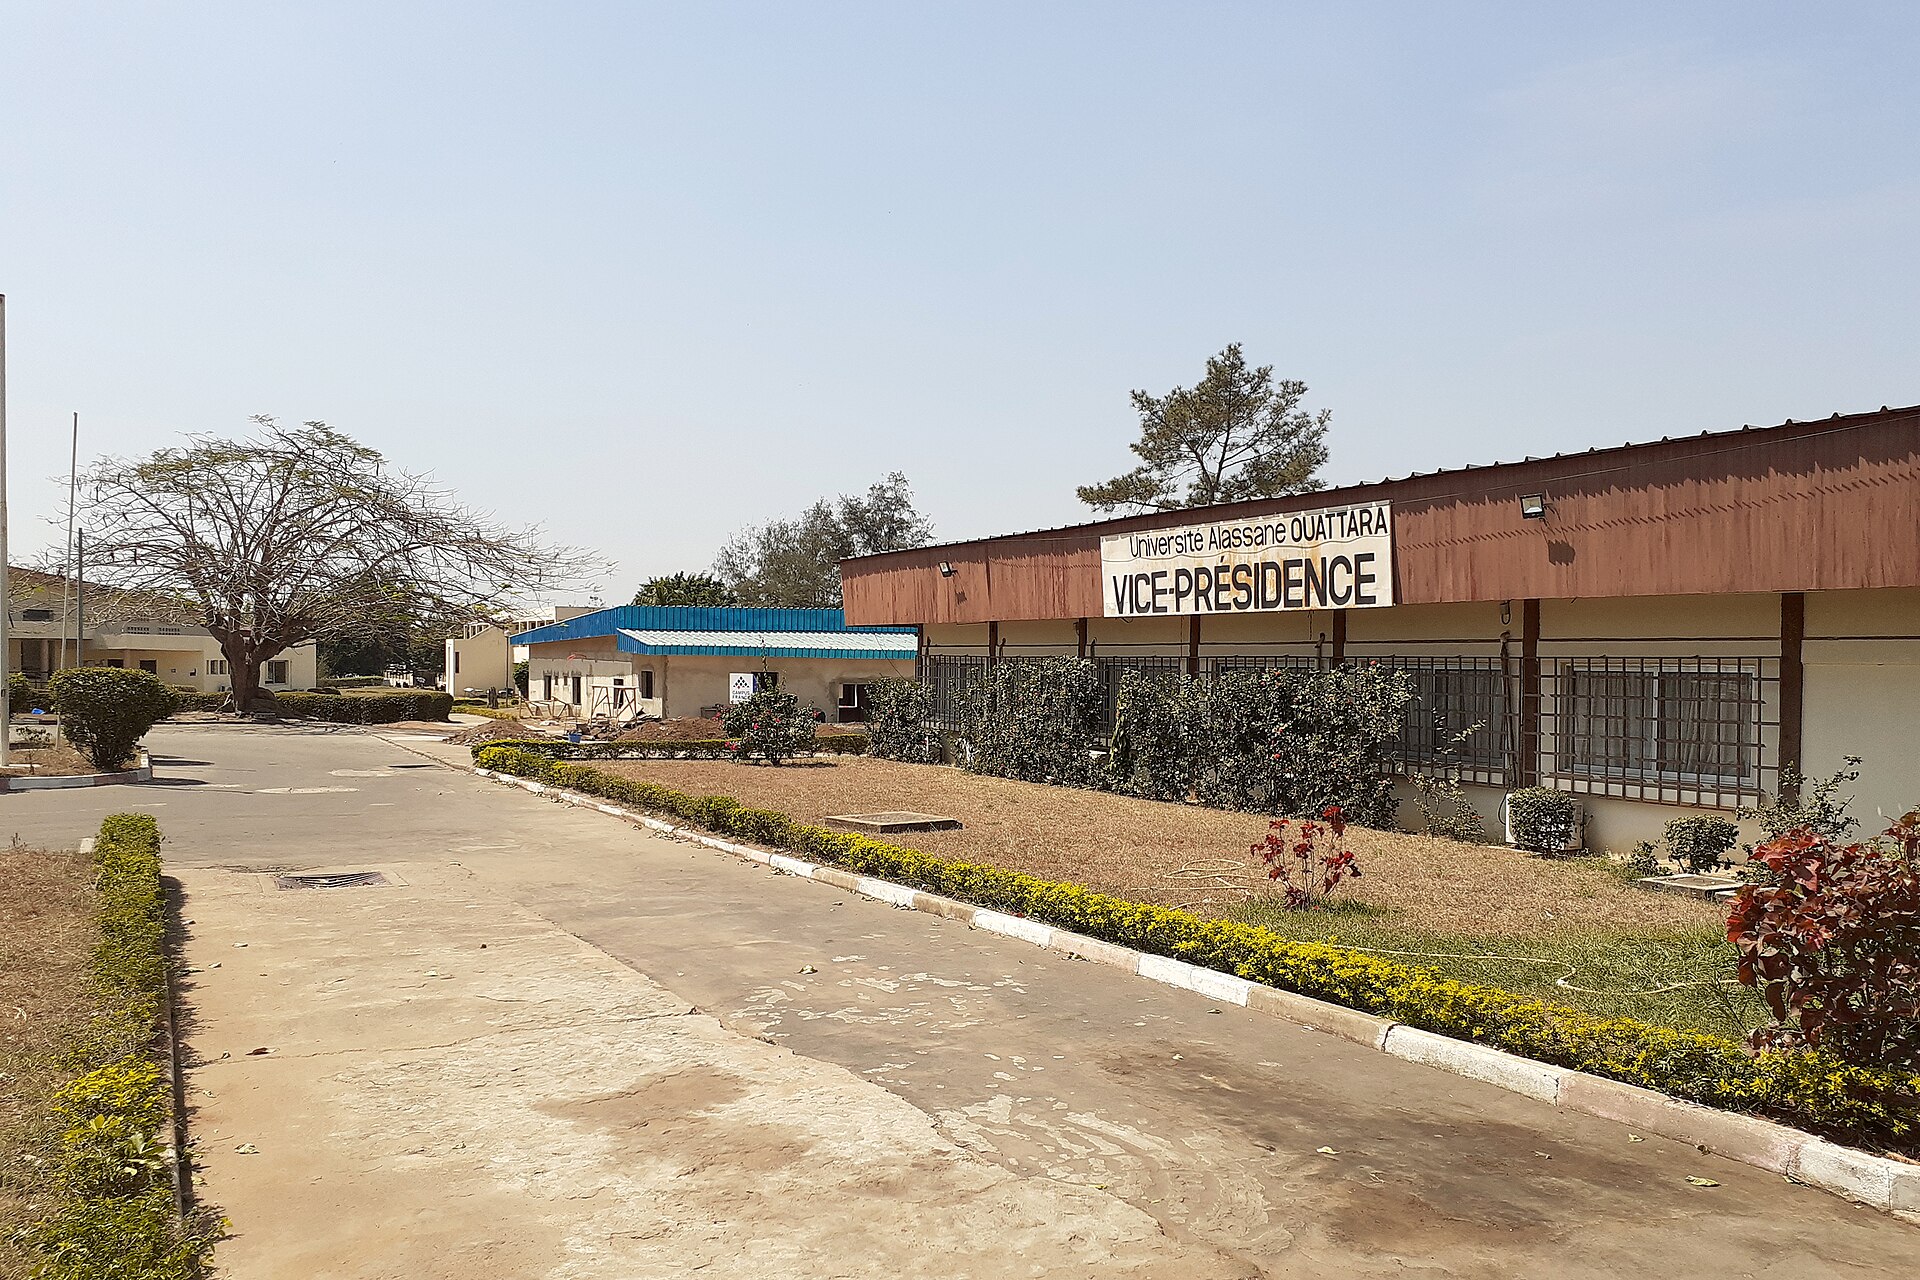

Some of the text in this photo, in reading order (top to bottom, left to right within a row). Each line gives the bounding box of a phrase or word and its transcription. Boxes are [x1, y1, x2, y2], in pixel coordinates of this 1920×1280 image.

[1130, 507, 1388, 558] Université Alassane OUATTARA
[1113, 552, 1377, 615] VICE-PRÉSIDENCE
